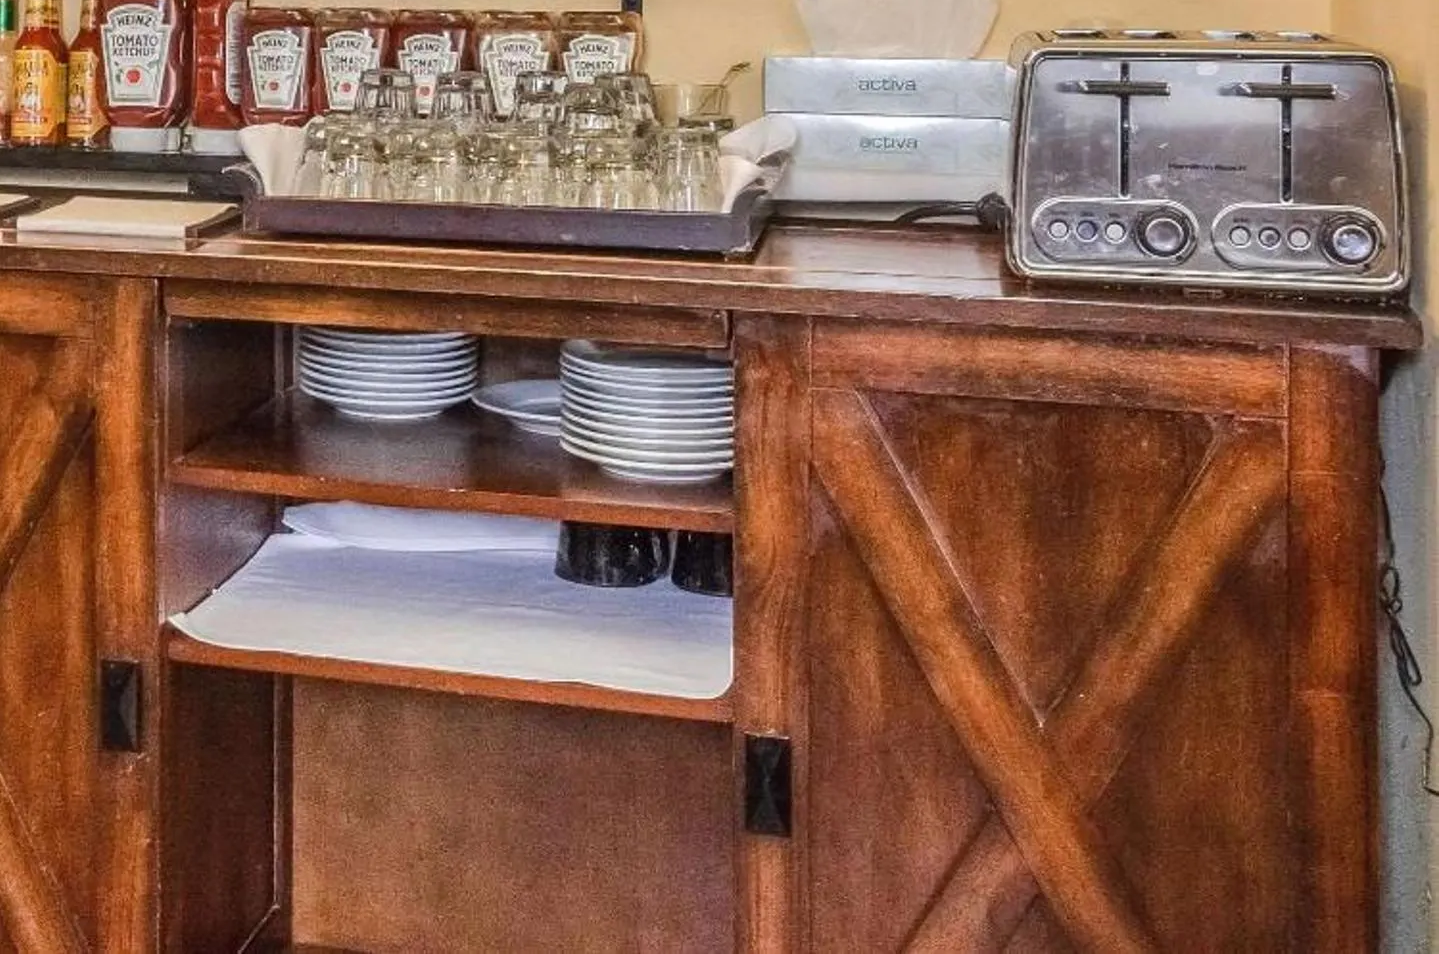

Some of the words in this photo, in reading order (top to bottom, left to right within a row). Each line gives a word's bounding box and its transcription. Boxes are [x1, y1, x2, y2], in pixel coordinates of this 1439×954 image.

[115, 14, 155, 27] HEINZ
[111, 33, 159, 47] TOMATO
[858, 76, 917, 92] activa
[860, 136, 919, 150] activa
